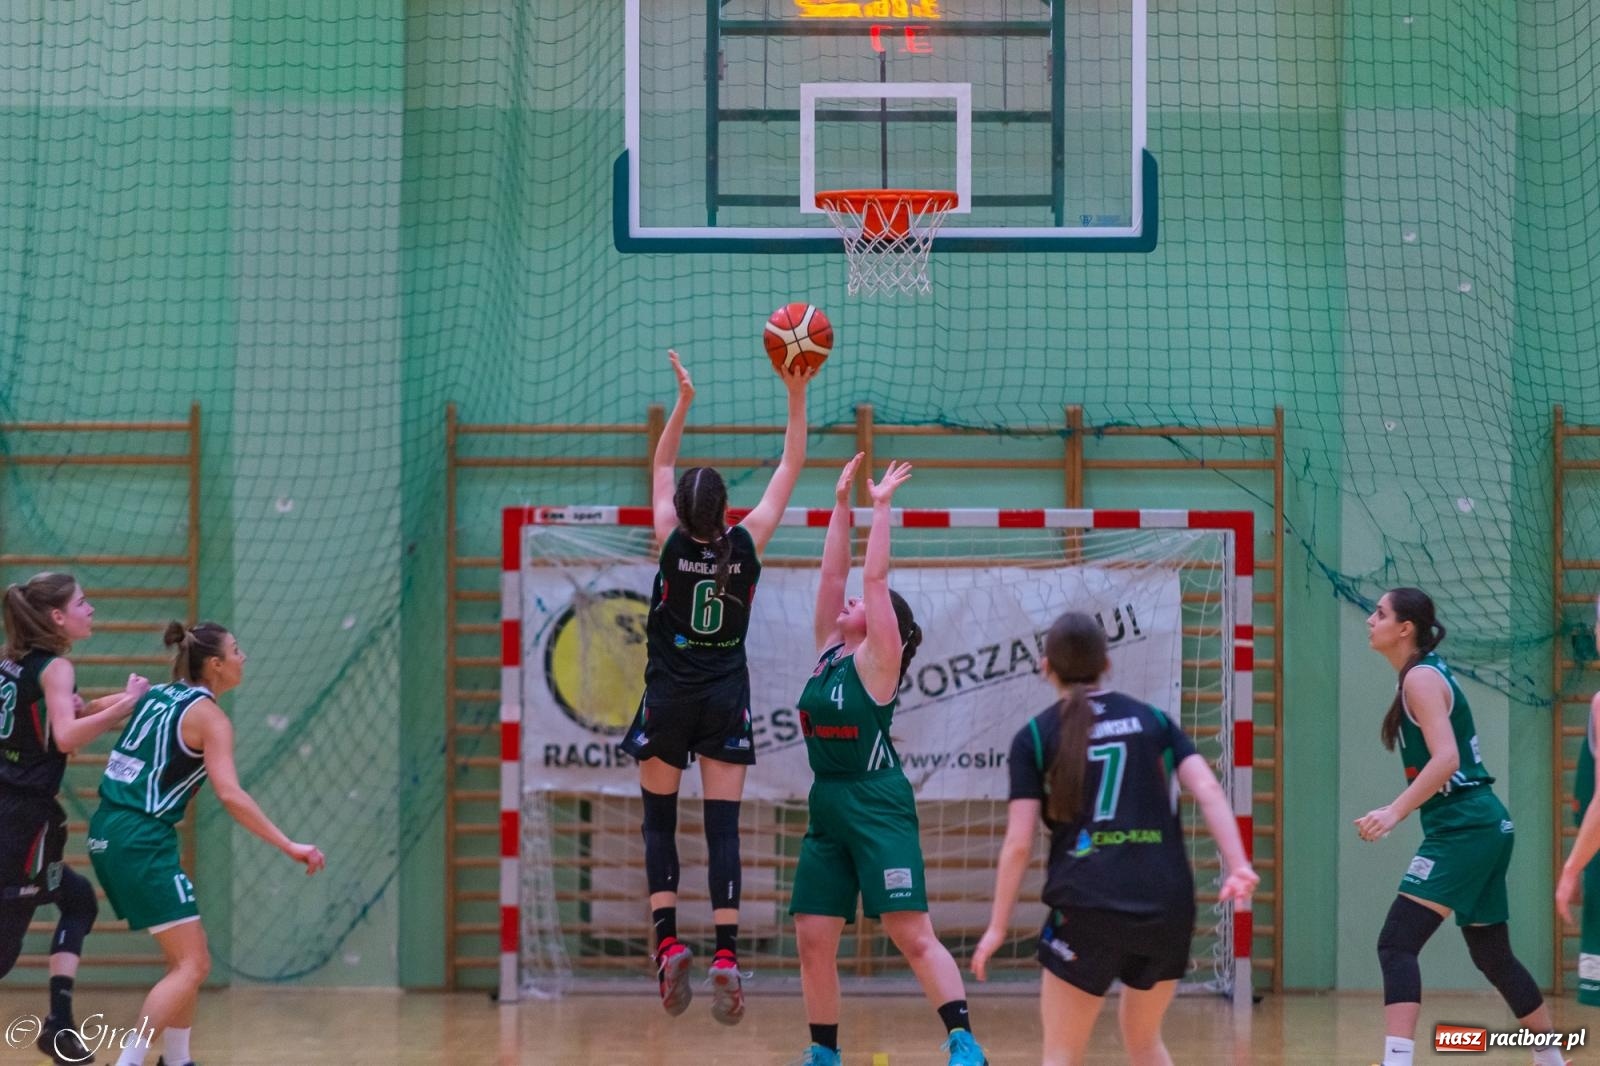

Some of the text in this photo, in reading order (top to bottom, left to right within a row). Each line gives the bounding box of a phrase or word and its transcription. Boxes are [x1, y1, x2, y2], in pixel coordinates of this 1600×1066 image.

[678, 558, 742, 575] MACIEJYK
[690, 579, 724, 635] 6
[830, 683, 844, 710] 4
[1087, 741, 1128, 822] 7
